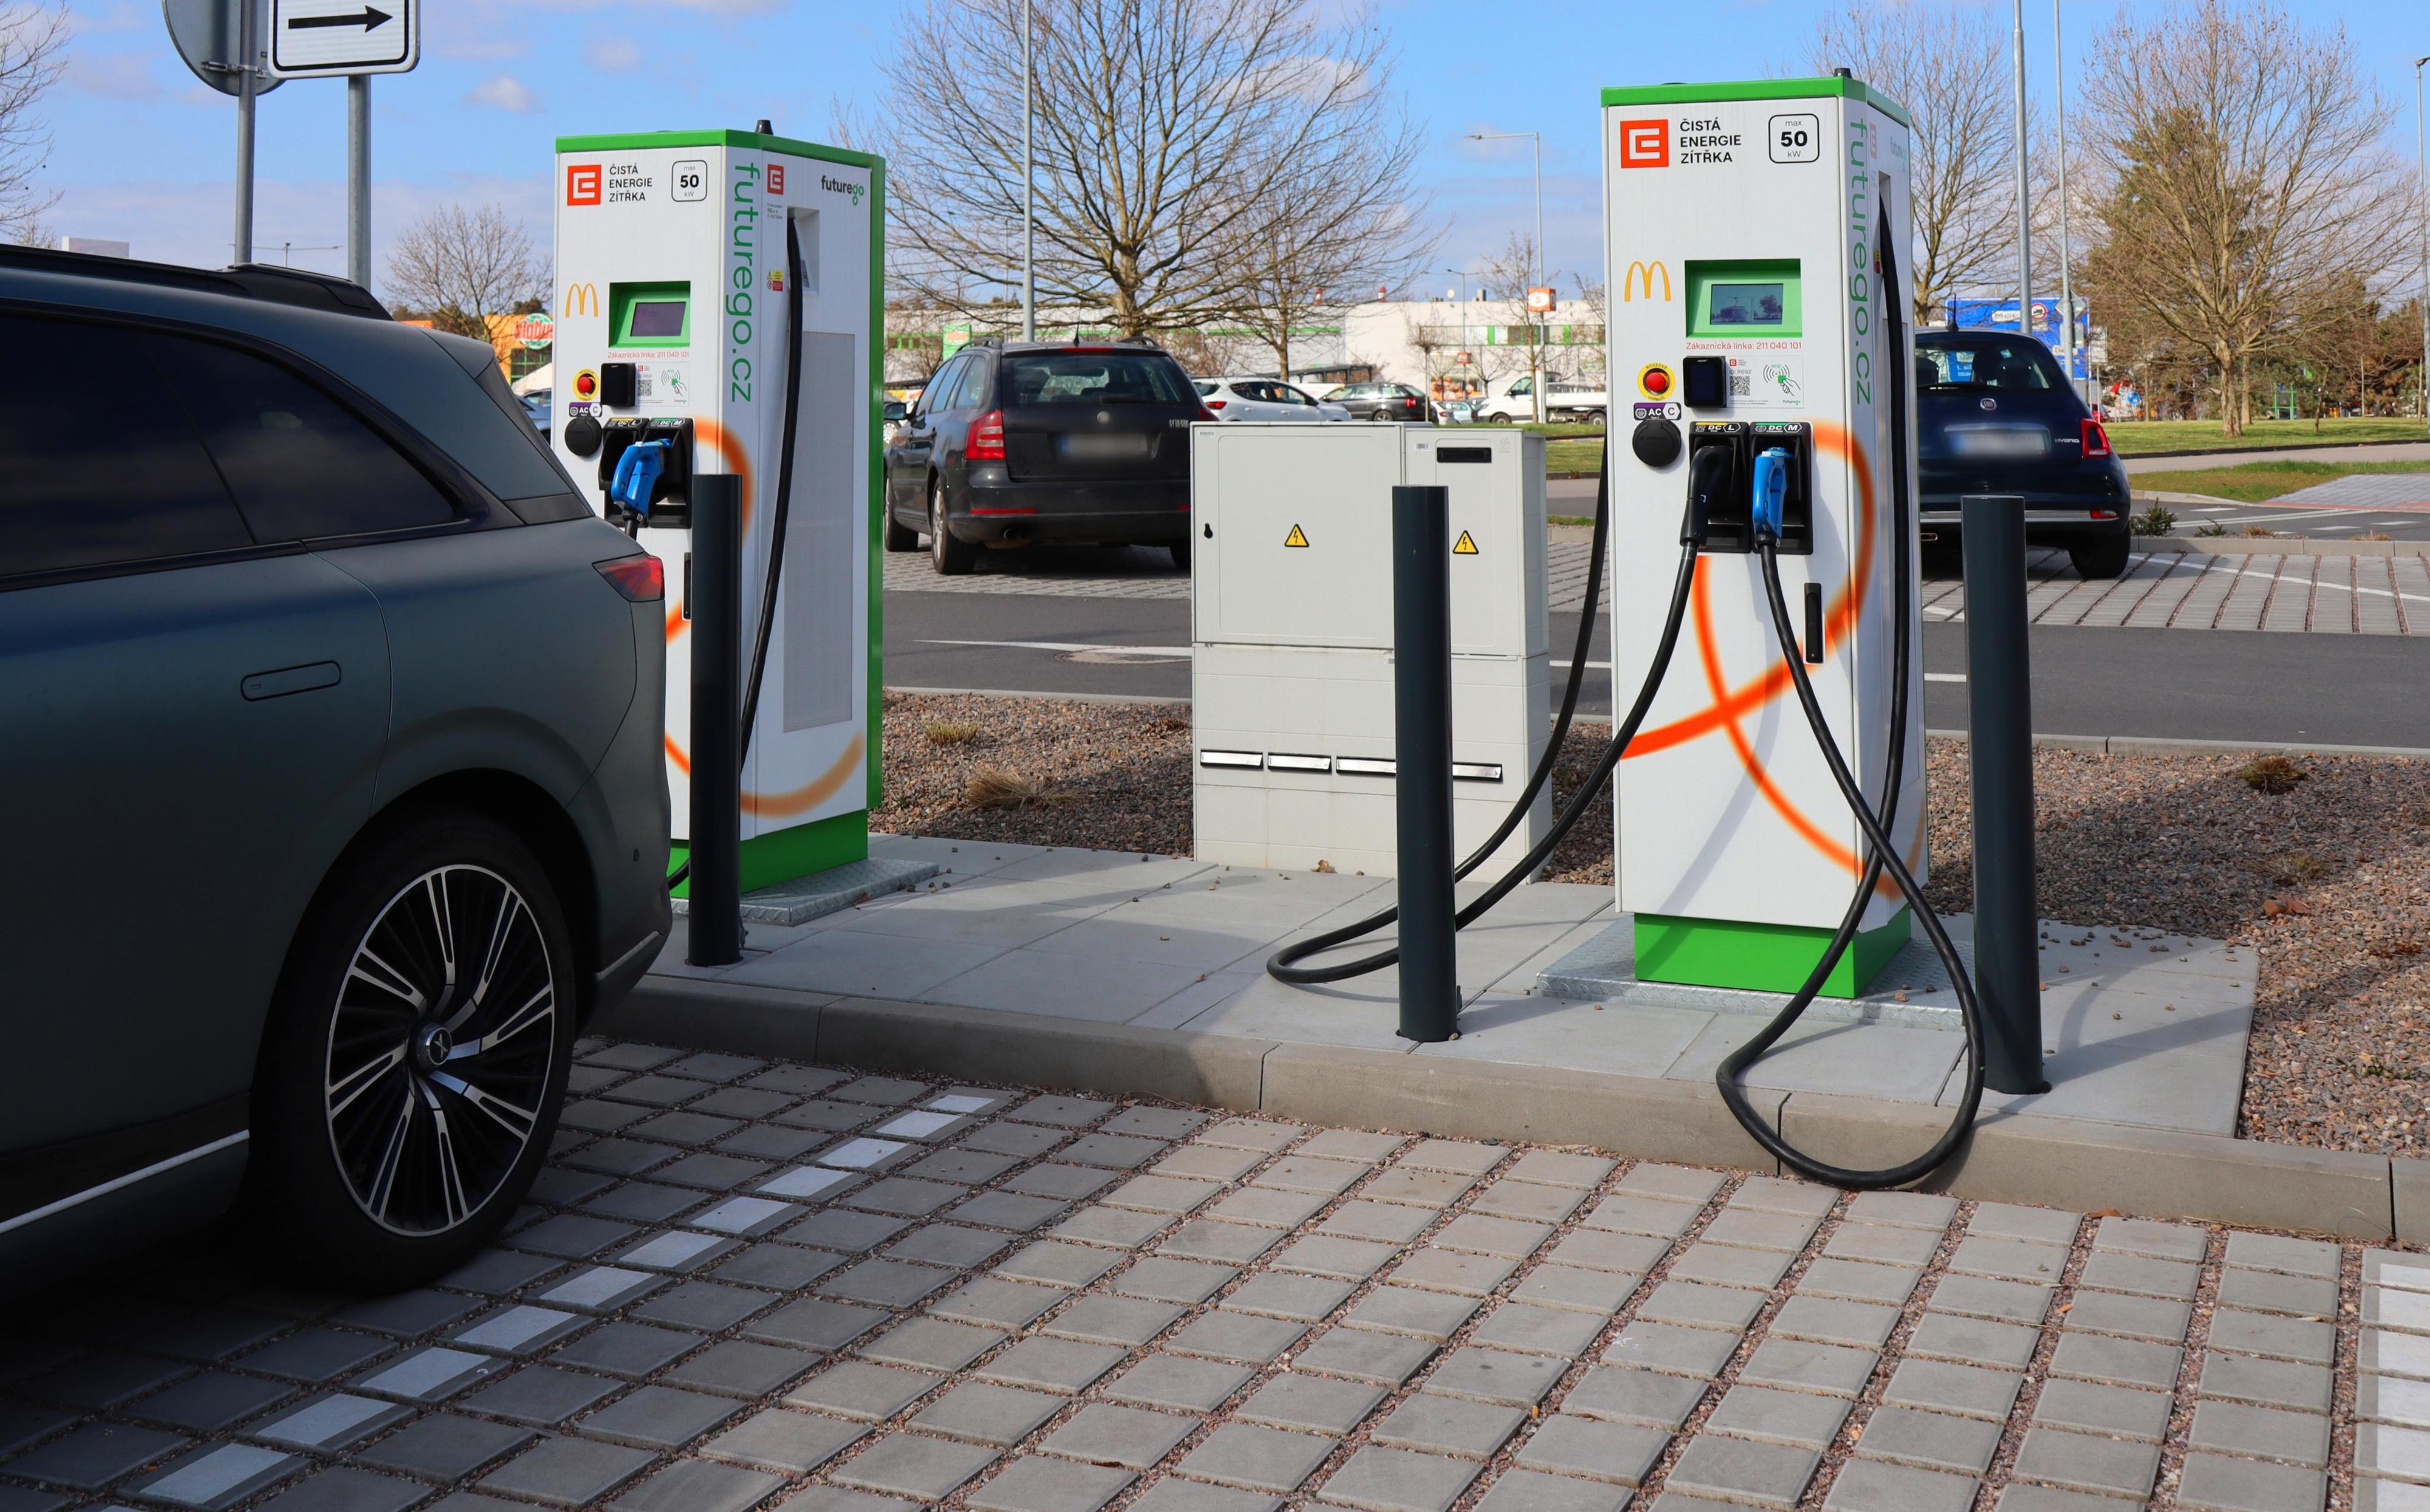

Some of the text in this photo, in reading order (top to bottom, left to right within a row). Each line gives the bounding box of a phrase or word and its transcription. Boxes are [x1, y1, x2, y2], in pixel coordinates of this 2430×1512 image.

[1680, 117, 1721, 132] ČISTÁ
[1680, 135, 1742, 148] ENERGIE
[1781, 131, 1809, 148] 50
[1681, 150, 1733, 164] ZÍTŘKA
[609, 163, 638, 176] ČISTÁ
[609, 177, 653, 189] ENERGIE
[680, 175, 699, 188] 50
[609, 190, 646, 203] ZÍTŘKA
[821, 175, 864, 206] futurego
[1849, 118, 1870, 405] futurego.cz
[725, 162, 761, 403] futurego.cz
